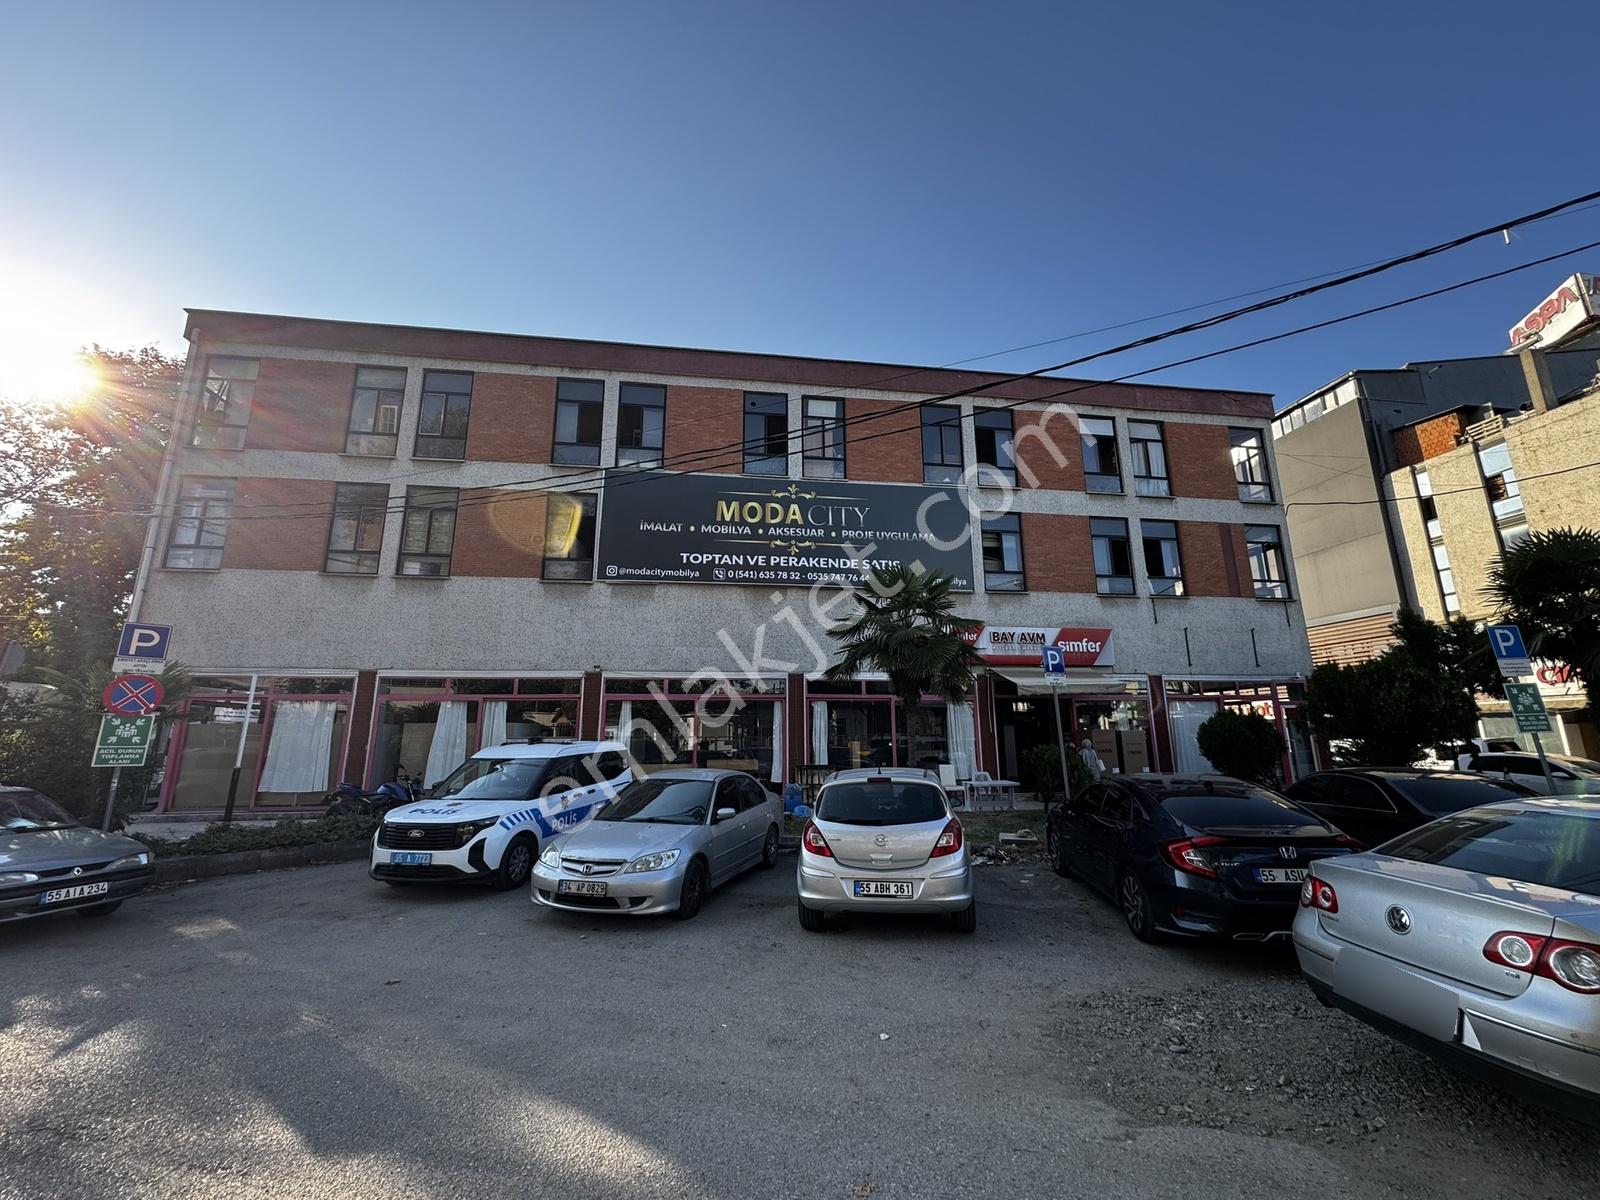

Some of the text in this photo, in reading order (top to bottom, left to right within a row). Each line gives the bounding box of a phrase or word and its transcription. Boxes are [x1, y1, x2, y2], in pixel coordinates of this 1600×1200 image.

[716, 500, 870, 527] MODA CITY
[640, 520, 936, 542] İMALAT MOBİLYA AKSESUAR PROJE UYGULAMA
[680, 553, 742, 565] TOPTAN
[747, 555, 766, 566] VE
[770, 556, 858, 569] PERAKENDE
[619, 567, 700, 577] @modacitymobilya
[735, 569, 757, 579] (541)
[759, 570, 775, 579] 635
[777, 571, 788, 579] 78
[790, 571, 800, 580] 32
[807, 572, 828, 581] 0535
[830, 573, 845, 581] 747
[848, 573, 858, 581] 76
[128, 628, 161, 655] P
[990, 632, 1046, 644] BAY AVM
[1057, 638, 1101, 653] simfer
[1495, 629, 1515, 656] P
[1047, 650, 1060, 671] P
[552, 811, 577, 832] POLİS
[1261, 870, 1276, 882] 55
[48, 891, 62, 901] 55
[87, 883, 107, 894] 234
[587, 883, 605, 893] 0829
[860, 883, 910, 894] 55 ABH 361
